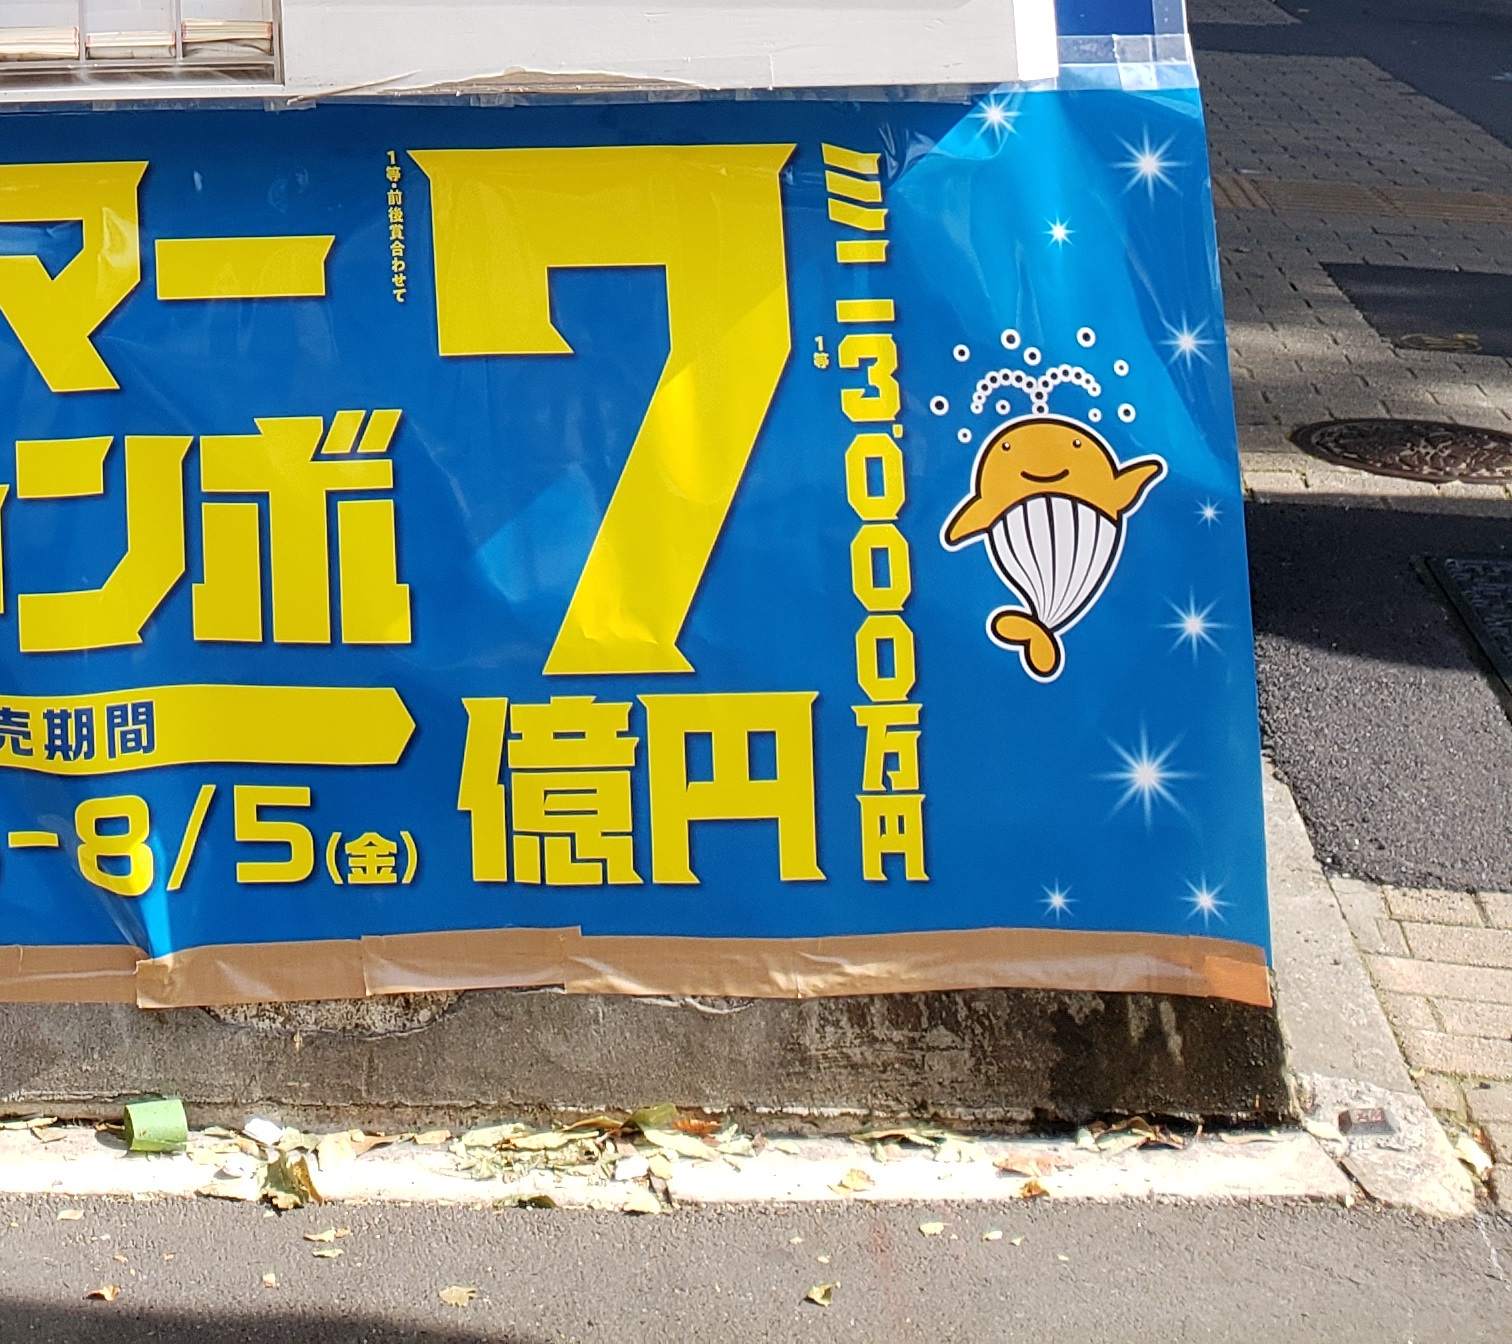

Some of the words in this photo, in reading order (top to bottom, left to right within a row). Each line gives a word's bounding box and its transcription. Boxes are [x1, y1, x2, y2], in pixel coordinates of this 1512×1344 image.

[385, 150, 407, 303] 1等・前後賞合わせて
[813, 335, 830, 369] 1等
[456, 690, 826, 886] 億円
